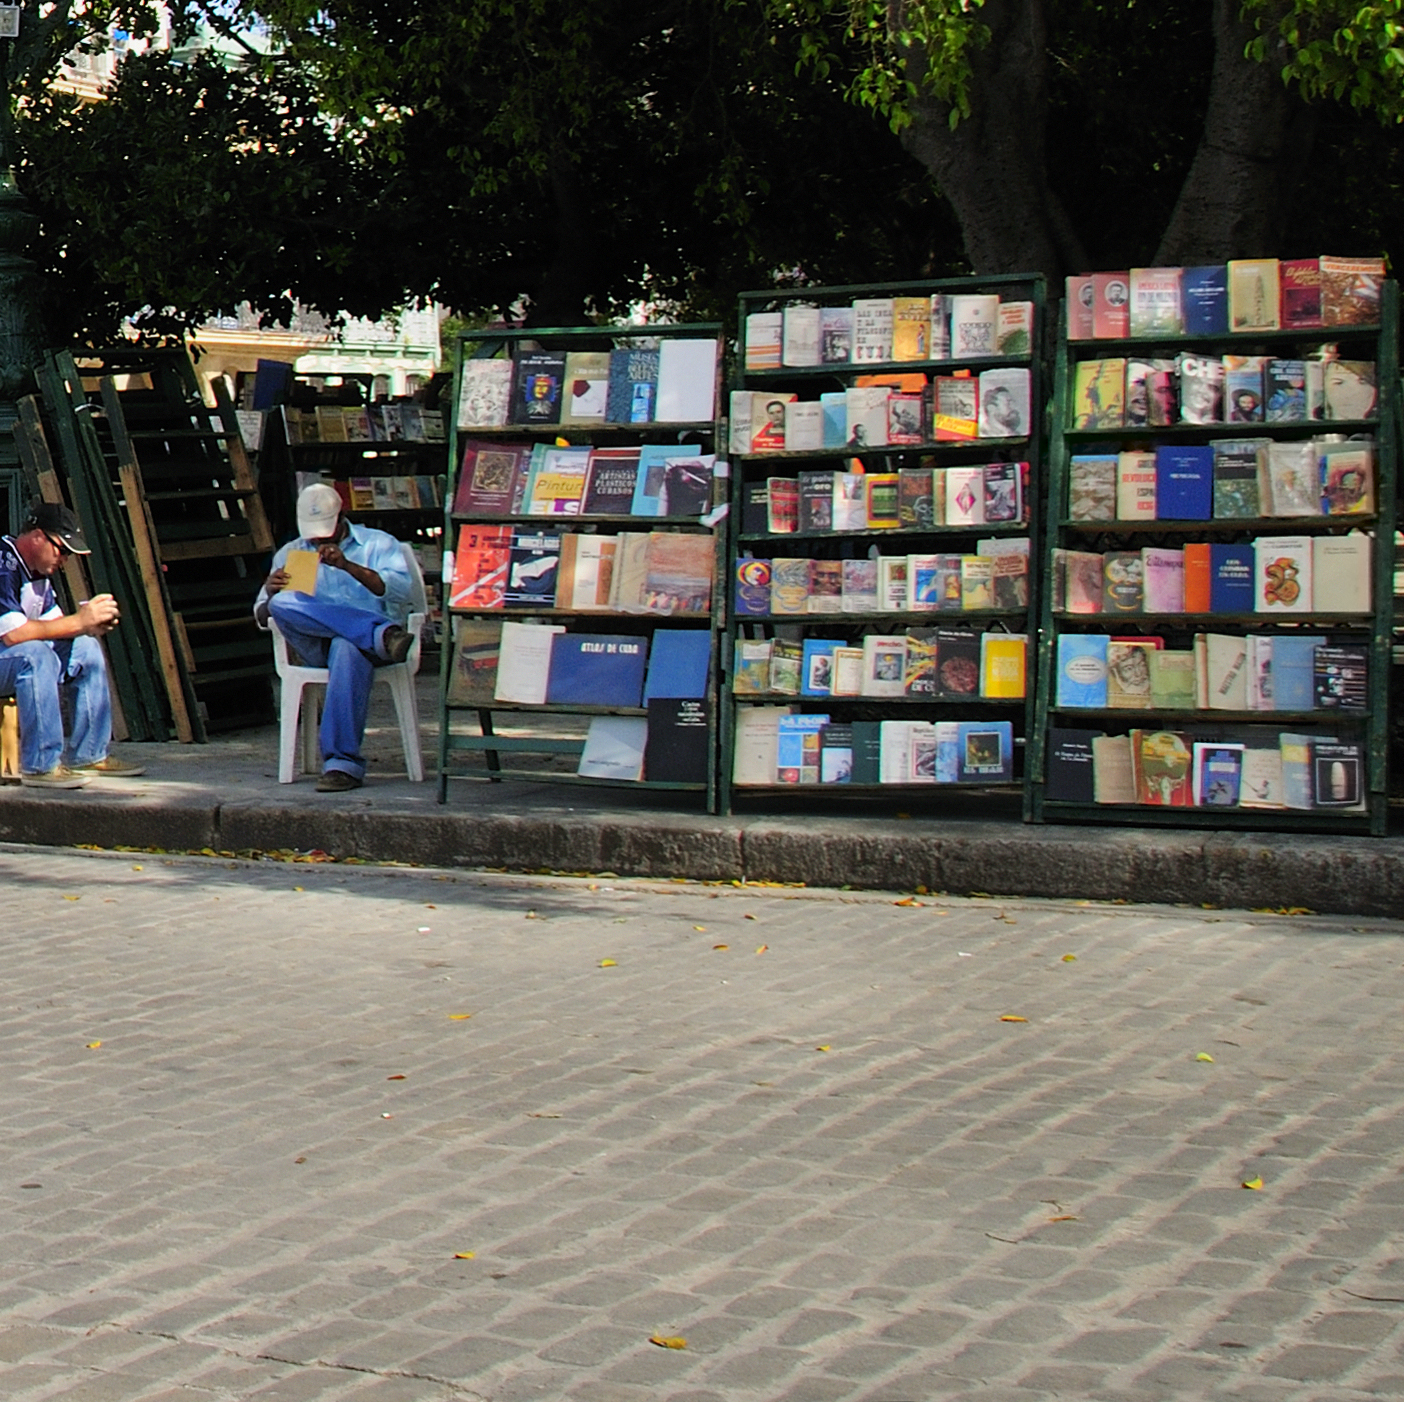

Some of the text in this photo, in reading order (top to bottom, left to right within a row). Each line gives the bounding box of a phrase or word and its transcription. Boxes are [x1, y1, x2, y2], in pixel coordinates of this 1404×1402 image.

[1181, 357, 1224, 378] CHE
[581, 642, 605, 653] ATLAS
[607, 643, 617, 654] DE
